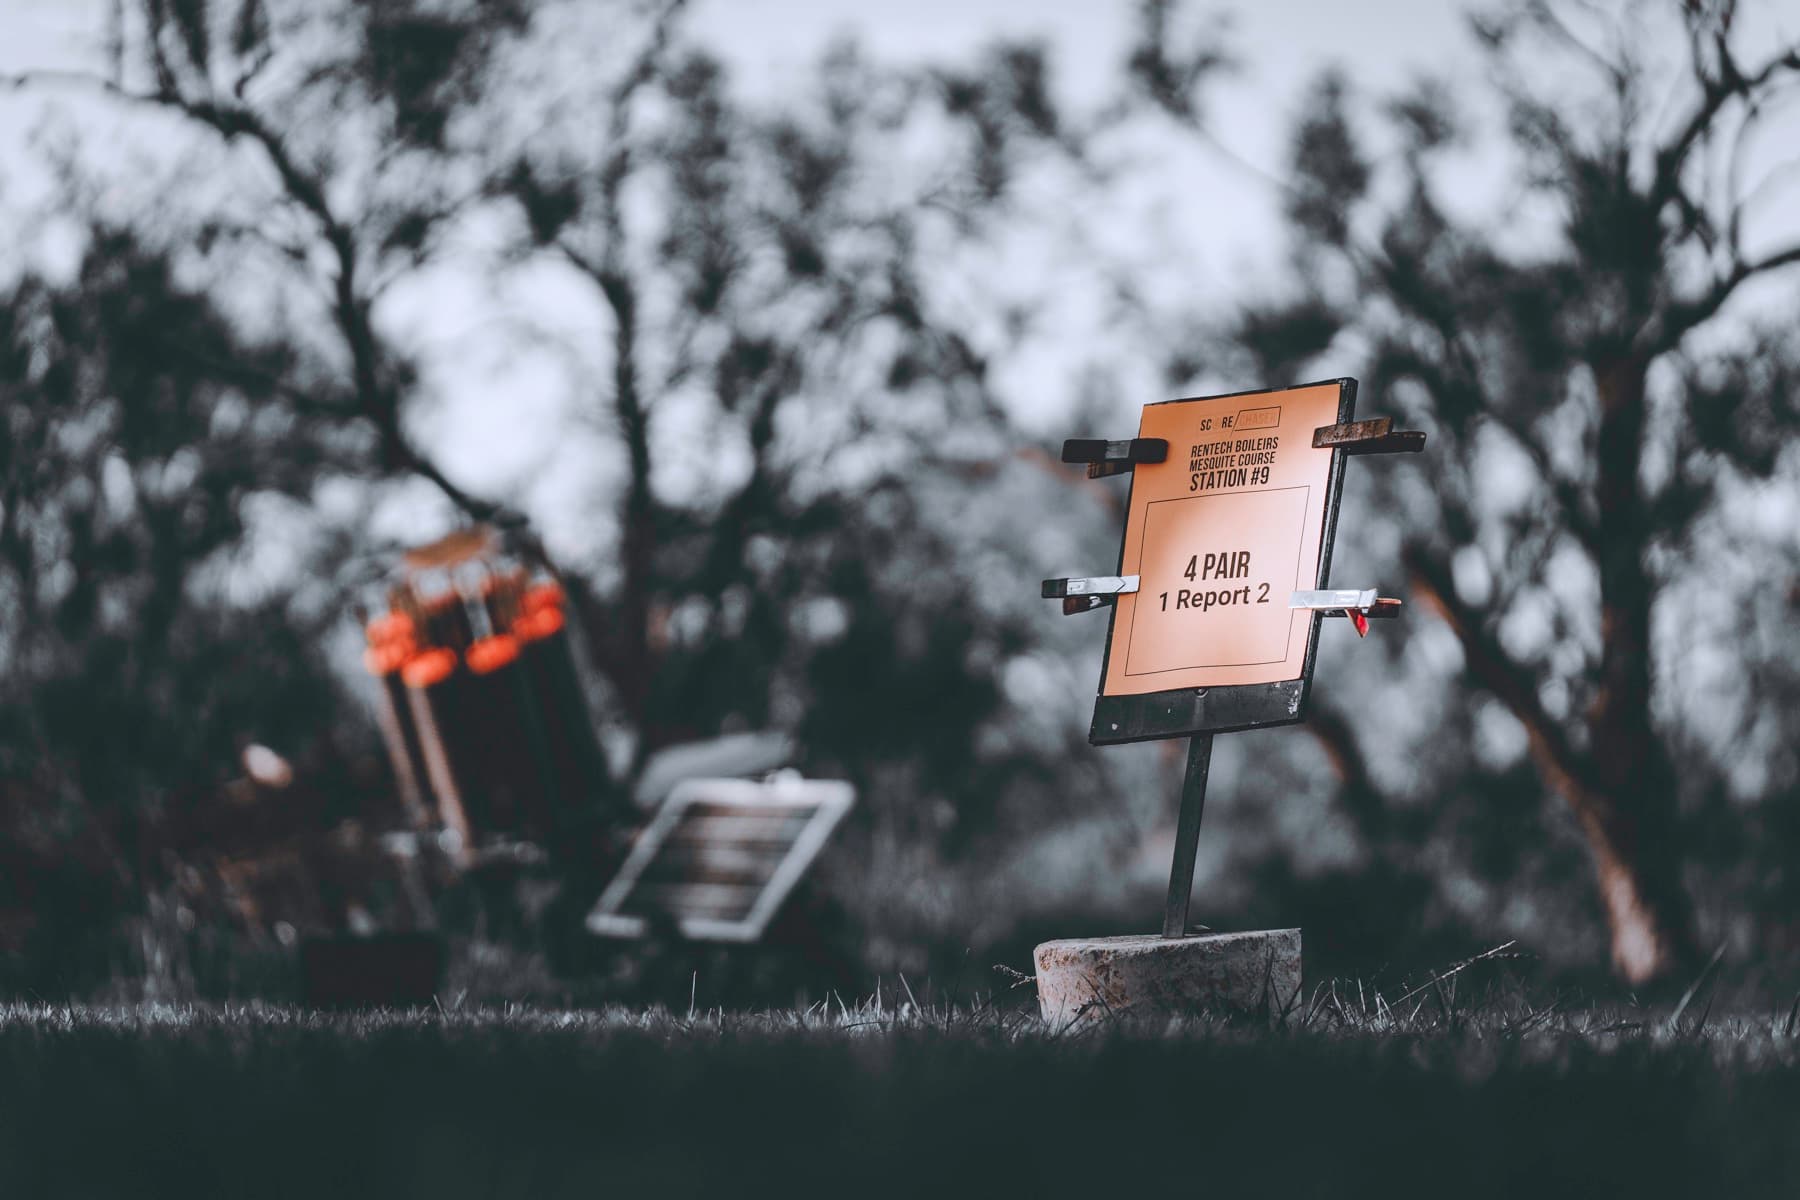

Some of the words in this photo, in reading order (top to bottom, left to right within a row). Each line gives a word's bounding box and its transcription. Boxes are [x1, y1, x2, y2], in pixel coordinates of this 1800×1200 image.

[1191, 441, 1233, 457] RENTECH
[1235, 437, 1279, 452] BOILEIRS
[1189, 455, 1236, 472] MESQUITE
[1238, 452, 1276, 467] COURSE
[1190, 468, 1247, 491] STATION
[1250, 466, 1270, 485] #9
[1184, 555, 1197, 581] 4
[1202, 551, 1251, 580] PAIR
[1159, 592, 1168, 612] 1
[1176, 586, 1251, 612] Report
[1257, 582, 1270, 603] 2
